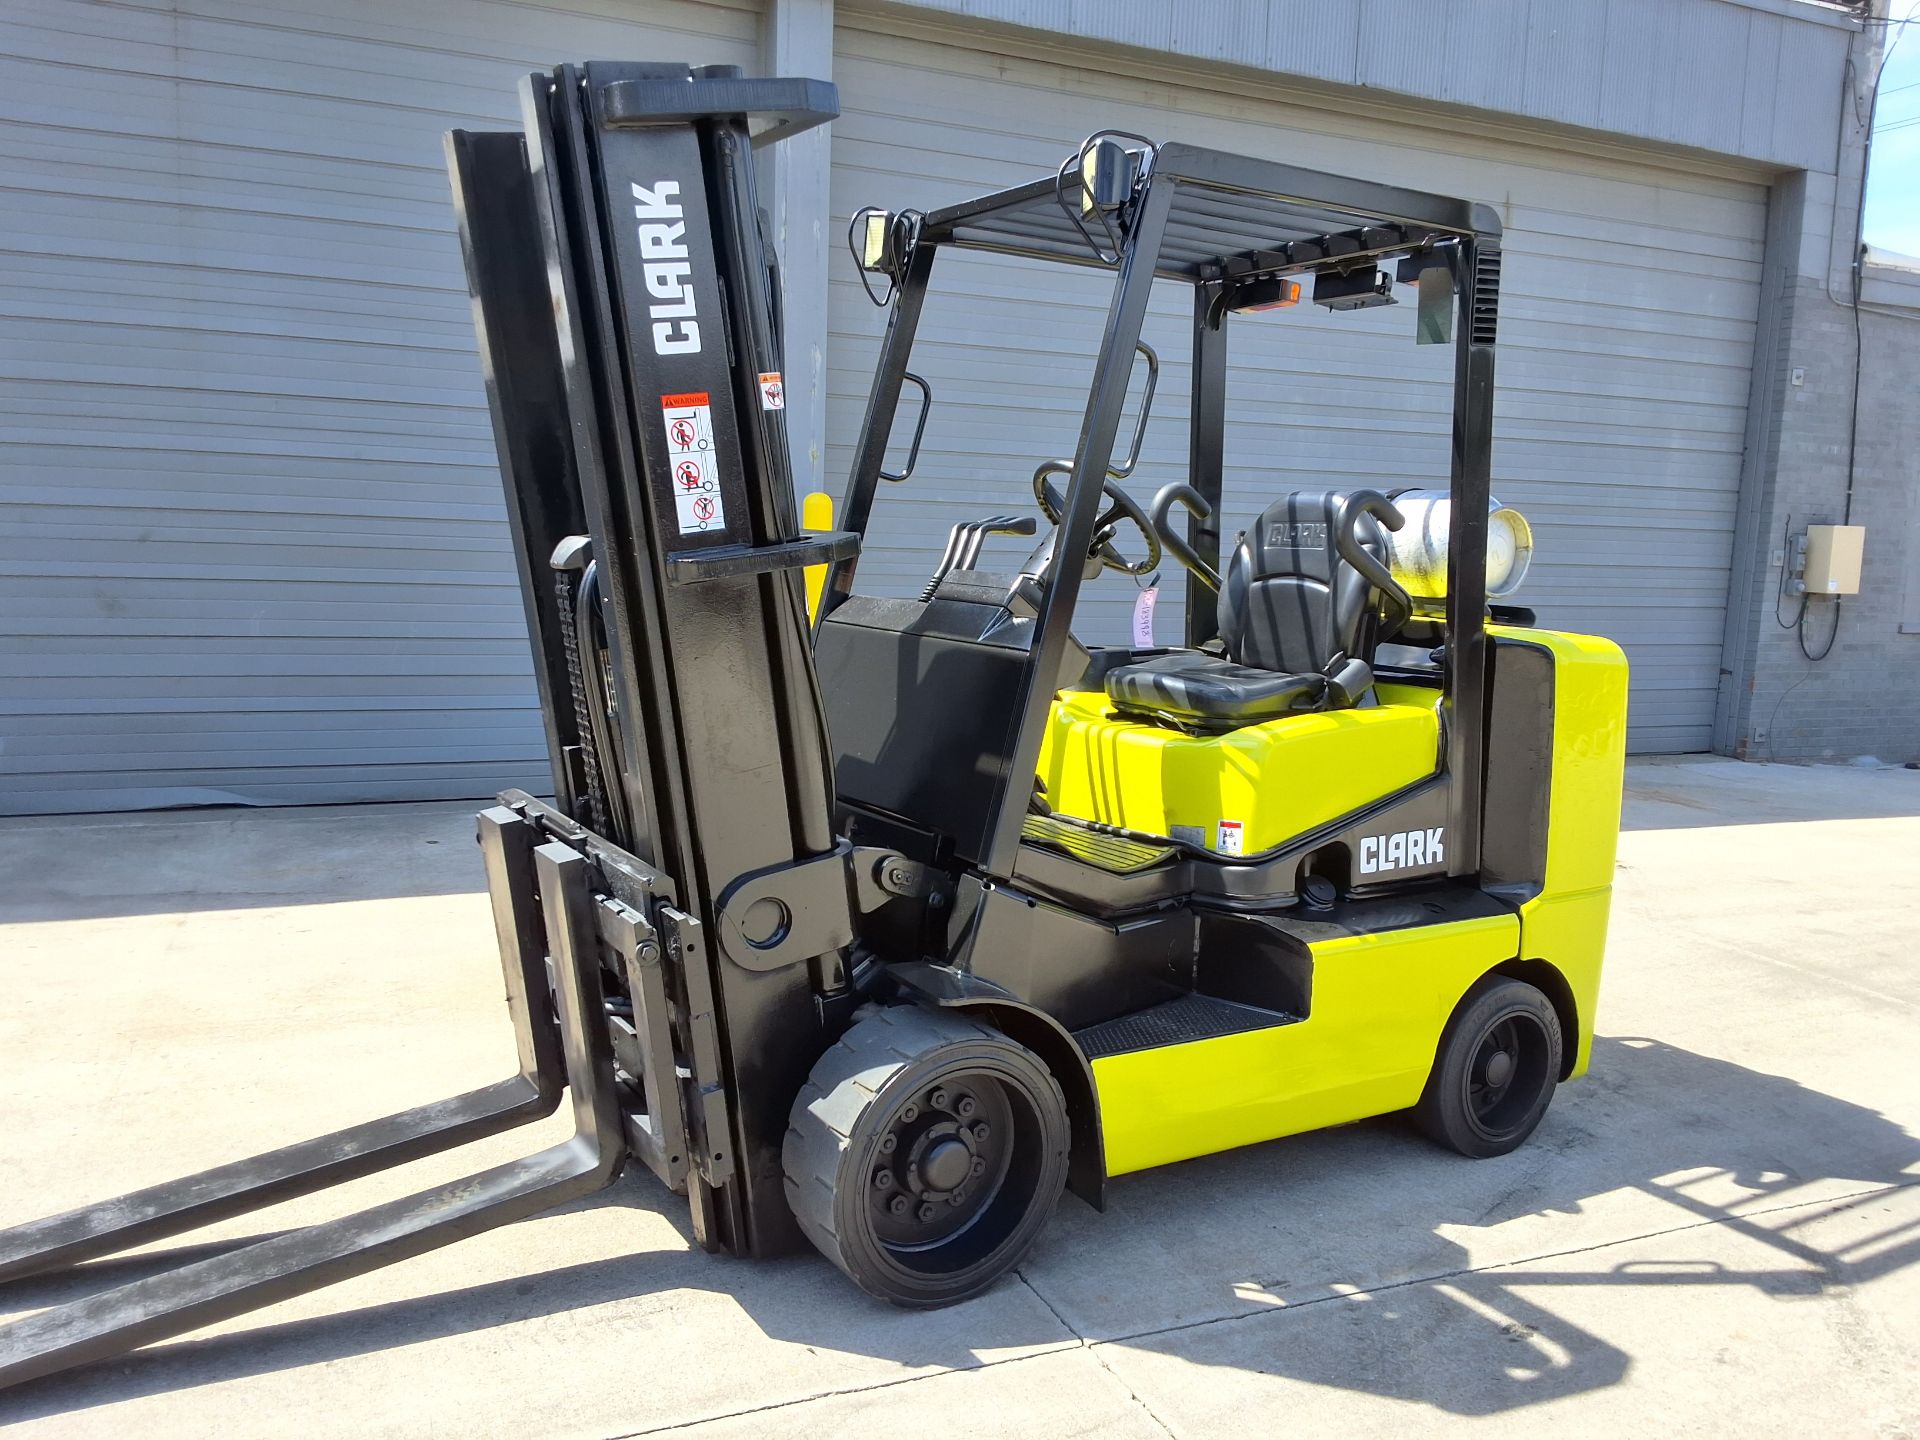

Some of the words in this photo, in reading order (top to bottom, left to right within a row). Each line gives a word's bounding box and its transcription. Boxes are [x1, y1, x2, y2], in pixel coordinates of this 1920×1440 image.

[631, 180, 701, 355] CLARK
[672, 395, 708, 406] WARNING
[1360, 827, 1444, 874] CLARK
